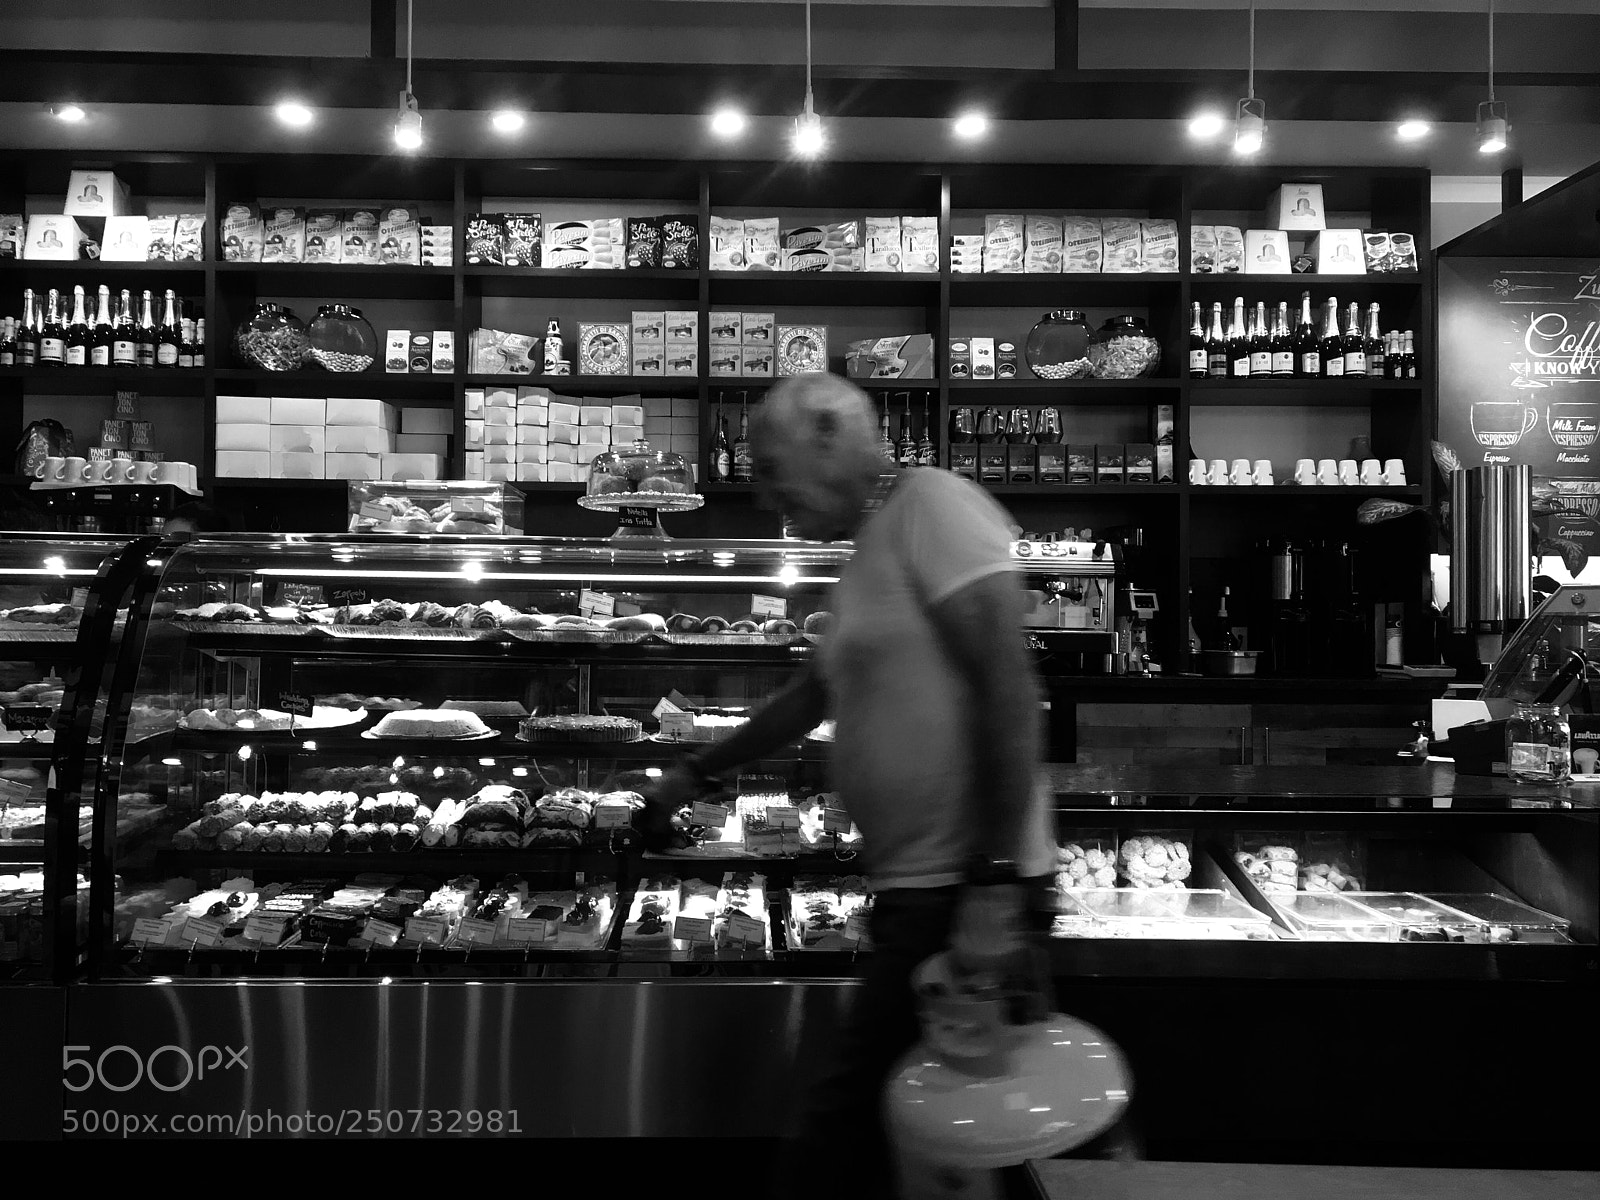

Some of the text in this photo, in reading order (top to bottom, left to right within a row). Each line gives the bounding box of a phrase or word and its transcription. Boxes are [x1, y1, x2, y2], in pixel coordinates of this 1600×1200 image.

[1525, 311, 1600, 370] Coff
[1534, 361, 1582, 375] KNOW
[1551, 419, 1574, 431] Milk
[103, 433, 122, 443] CINO
[1478, 433, 1519, 446] ESPRESSO
[1553, 434, 1595, 447] ESPRESSO
[90, 448, 112, 457] PANET
[1483, 451, 1511, 465] Espresso
[1556, 452, 1591, 463] Macchiato
[1557, 526, 1595, 539] Cappuccino
